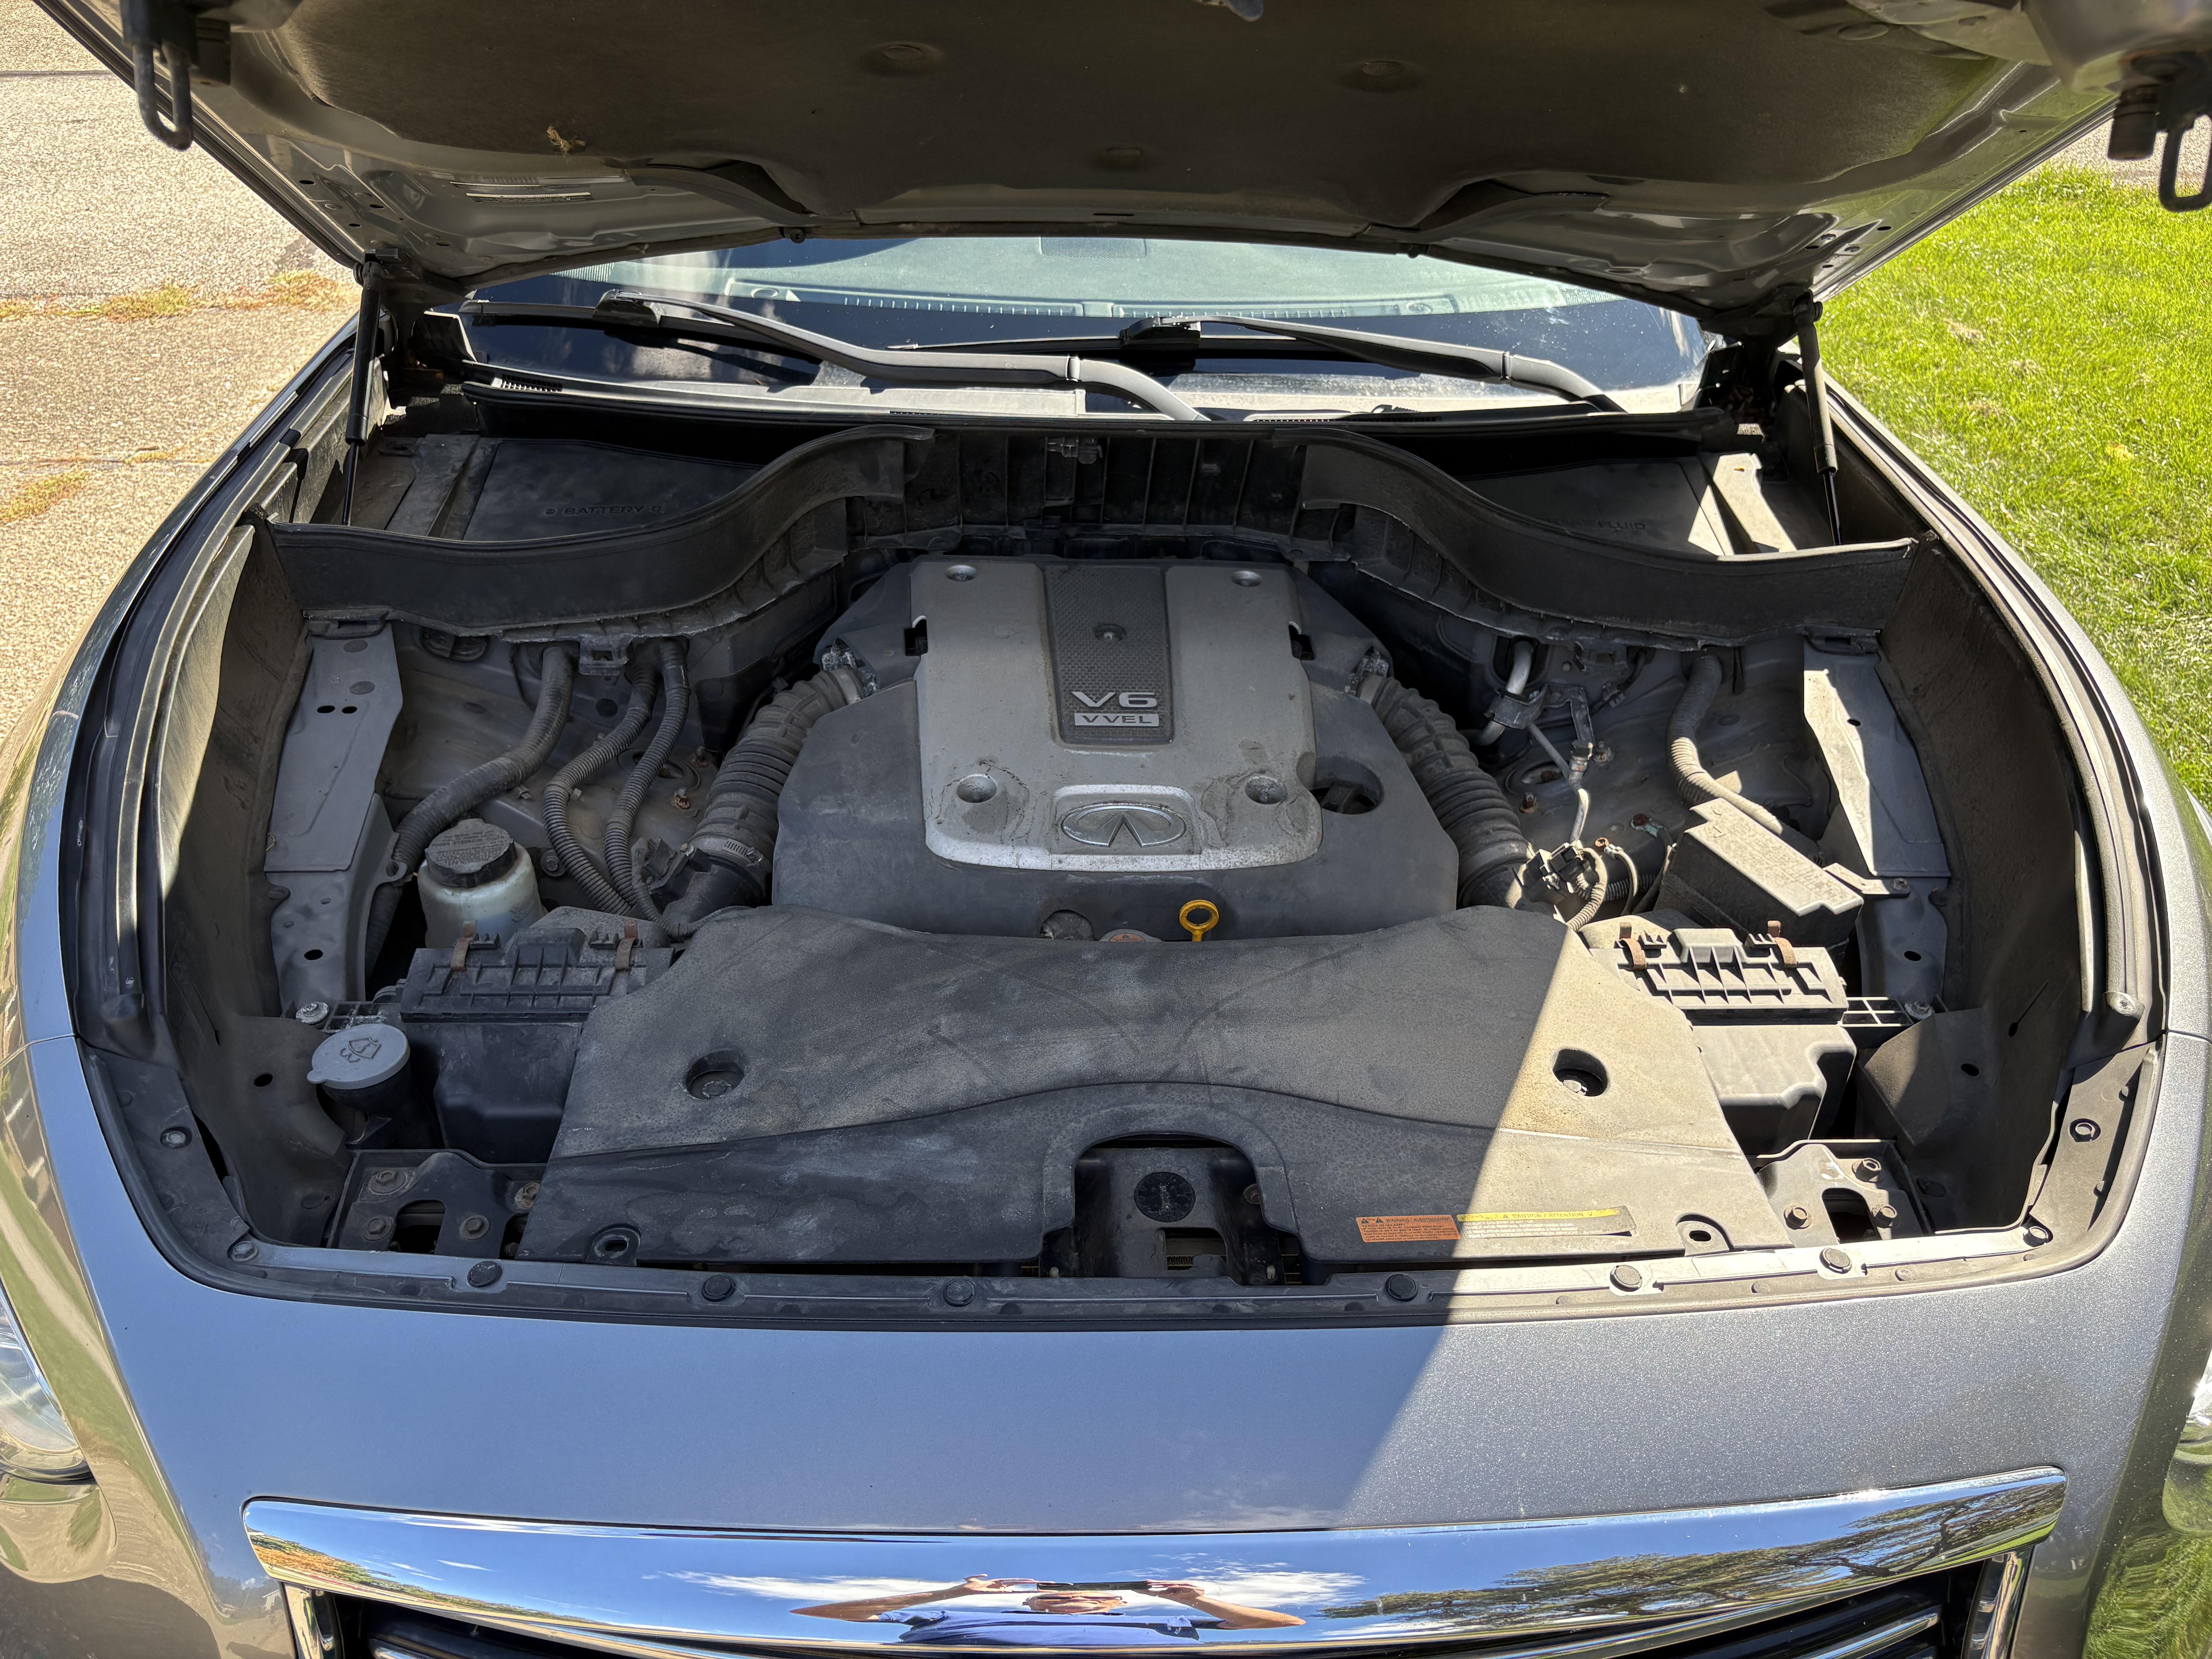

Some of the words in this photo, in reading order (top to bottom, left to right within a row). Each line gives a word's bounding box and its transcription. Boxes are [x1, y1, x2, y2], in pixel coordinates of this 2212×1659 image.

[564, 505, 646, 515] BATTERY
[1598, 520, 1646, 530] FLUID
[1071, 692, 1158, 708] V6
[1080, 714, 1154, 725] VVEL
